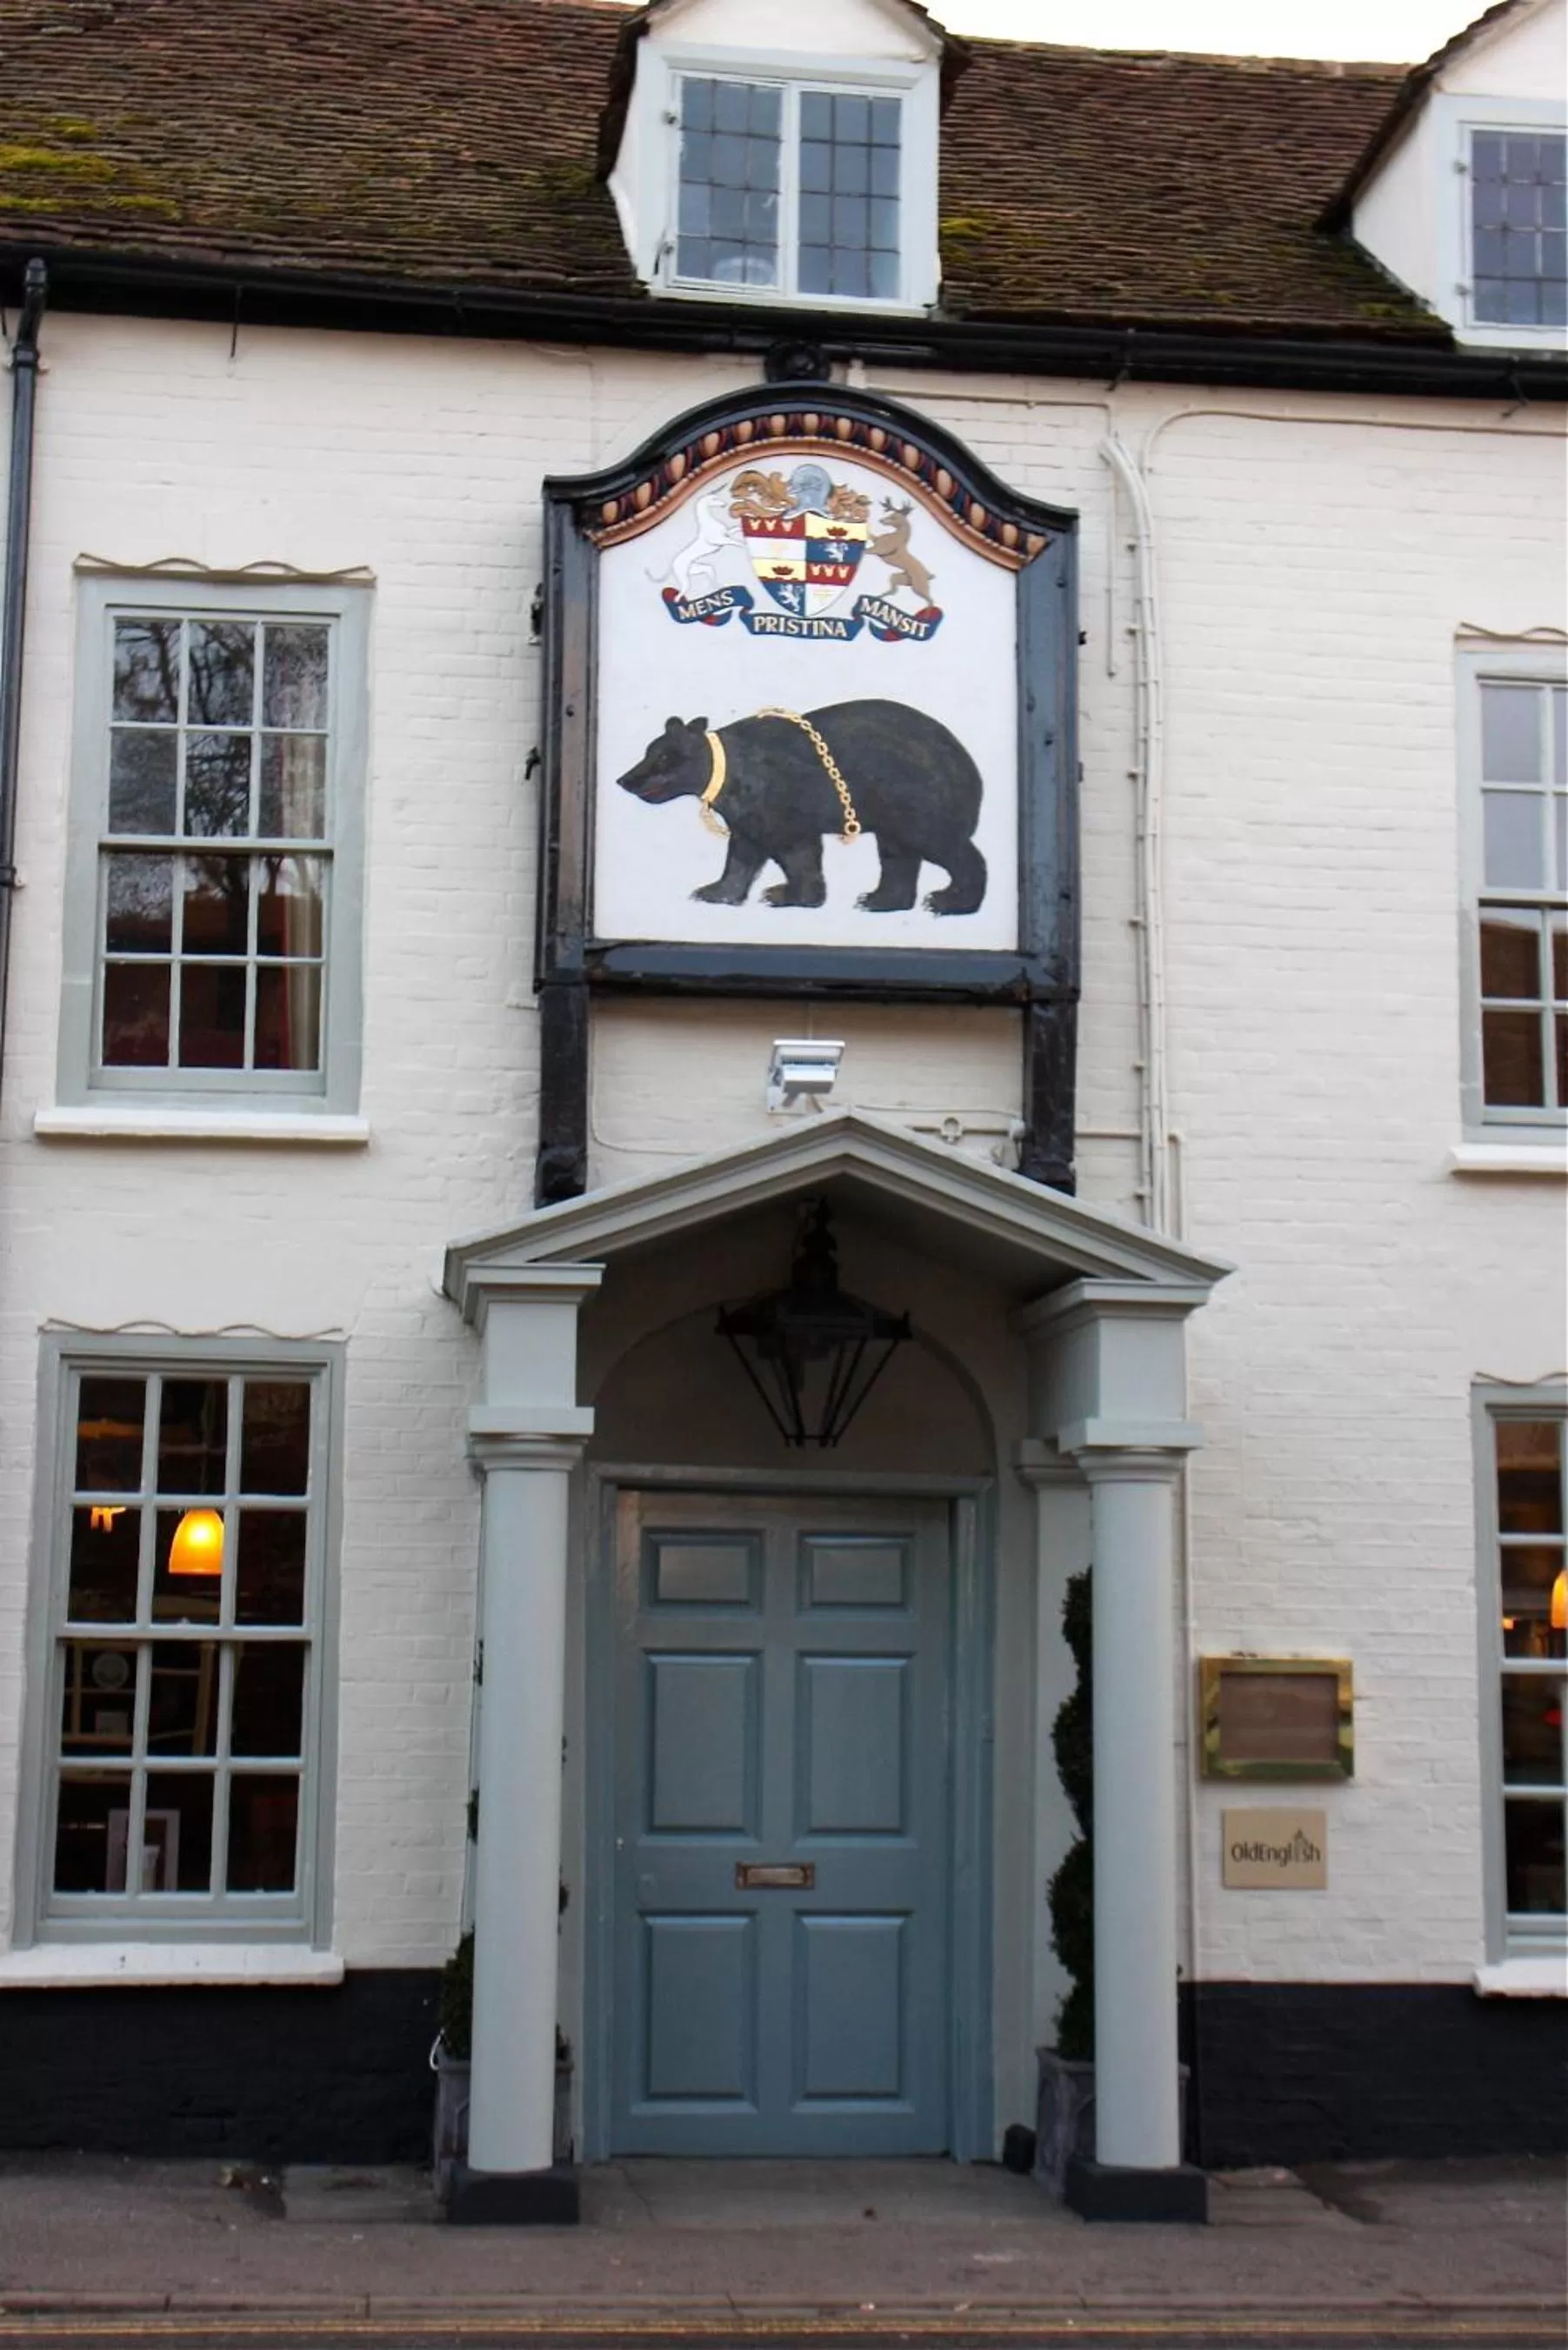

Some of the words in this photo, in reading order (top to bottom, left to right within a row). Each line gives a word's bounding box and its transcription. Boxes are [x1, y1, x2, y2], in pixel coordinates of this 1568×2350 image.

[677, 590, 734, 620] MENS
[753, 615, 847, 638] PRISTINA
[860, 598, 929, 638] MANSIT
